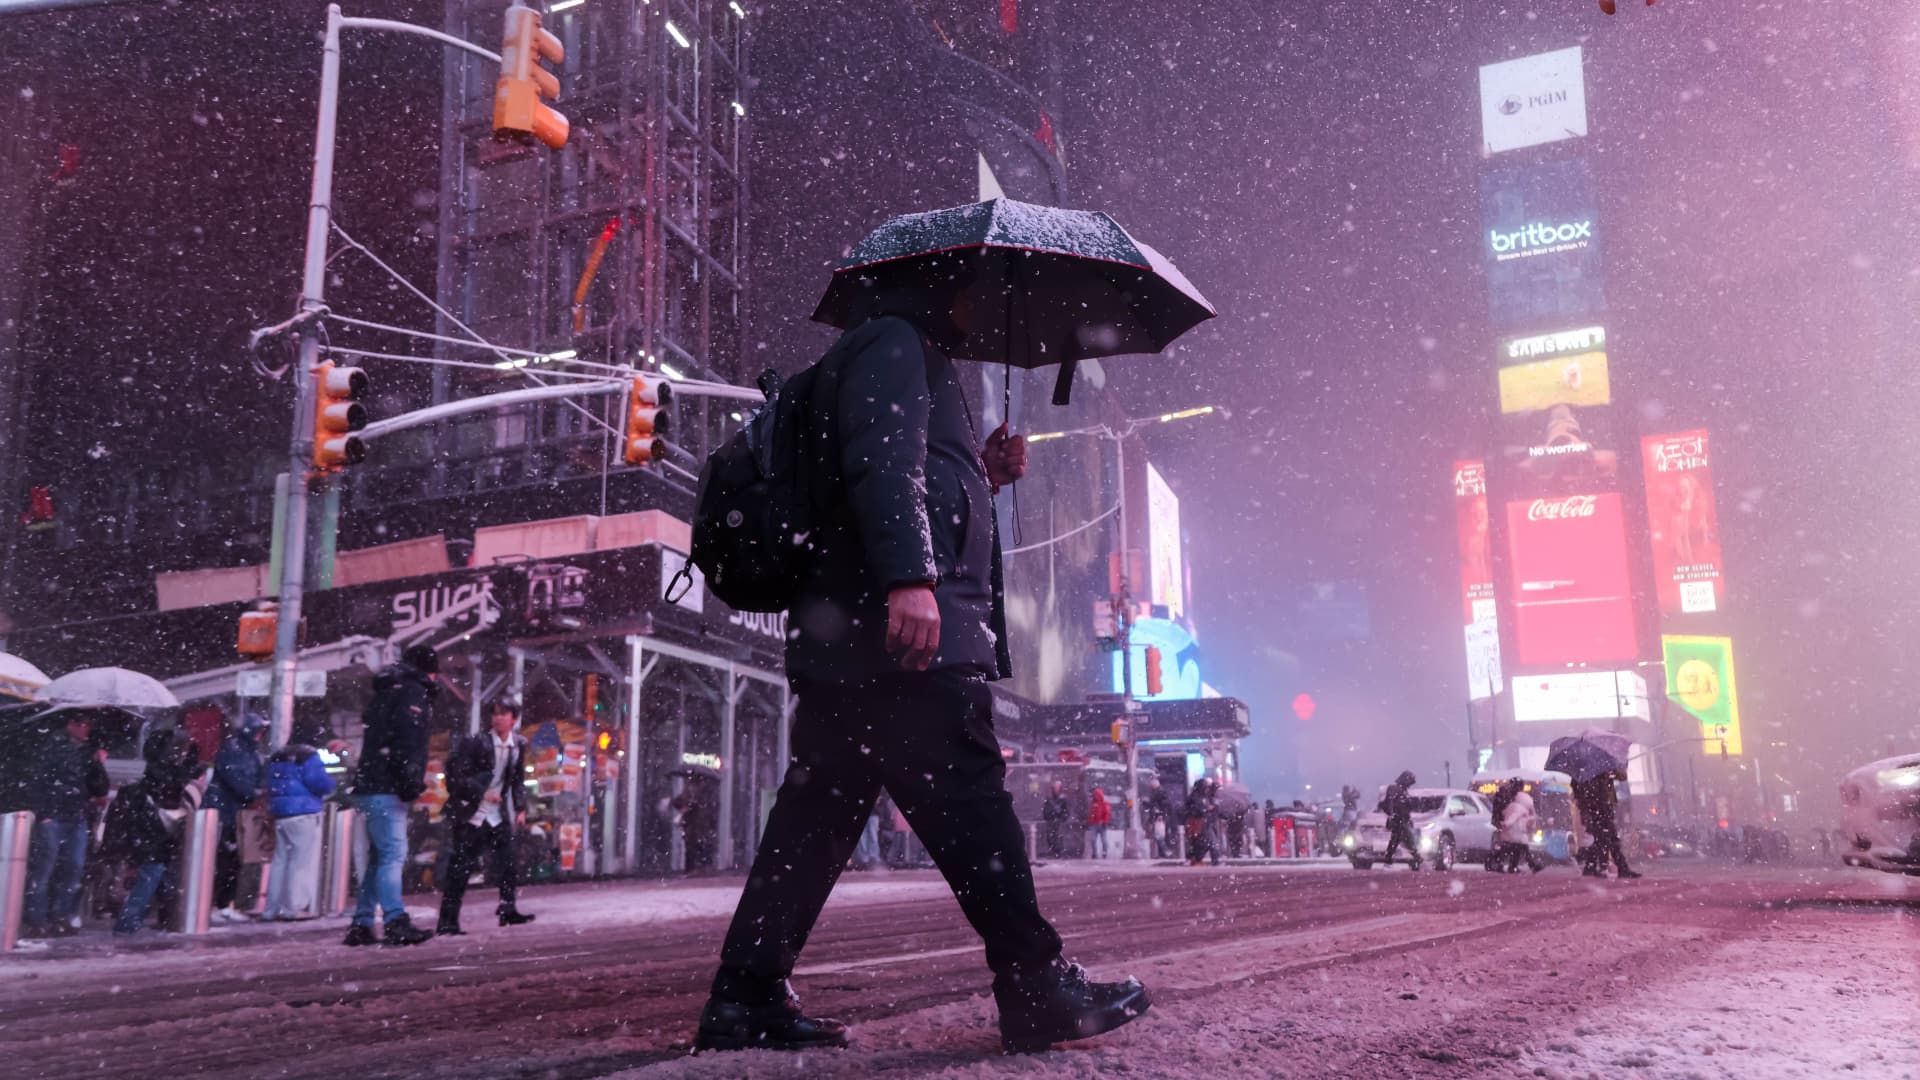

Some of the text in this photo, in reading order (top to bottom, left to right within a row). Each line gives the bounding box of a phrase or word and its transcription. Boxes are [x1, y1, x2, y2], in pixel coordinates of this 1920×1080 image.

[1528, 89, 1567, 108] PGIM
[1491, 220, 1591, 251] britbox
[1508, 330, 1591, 358] SAMSUNG
[1529, 446, 1544, 457] No
